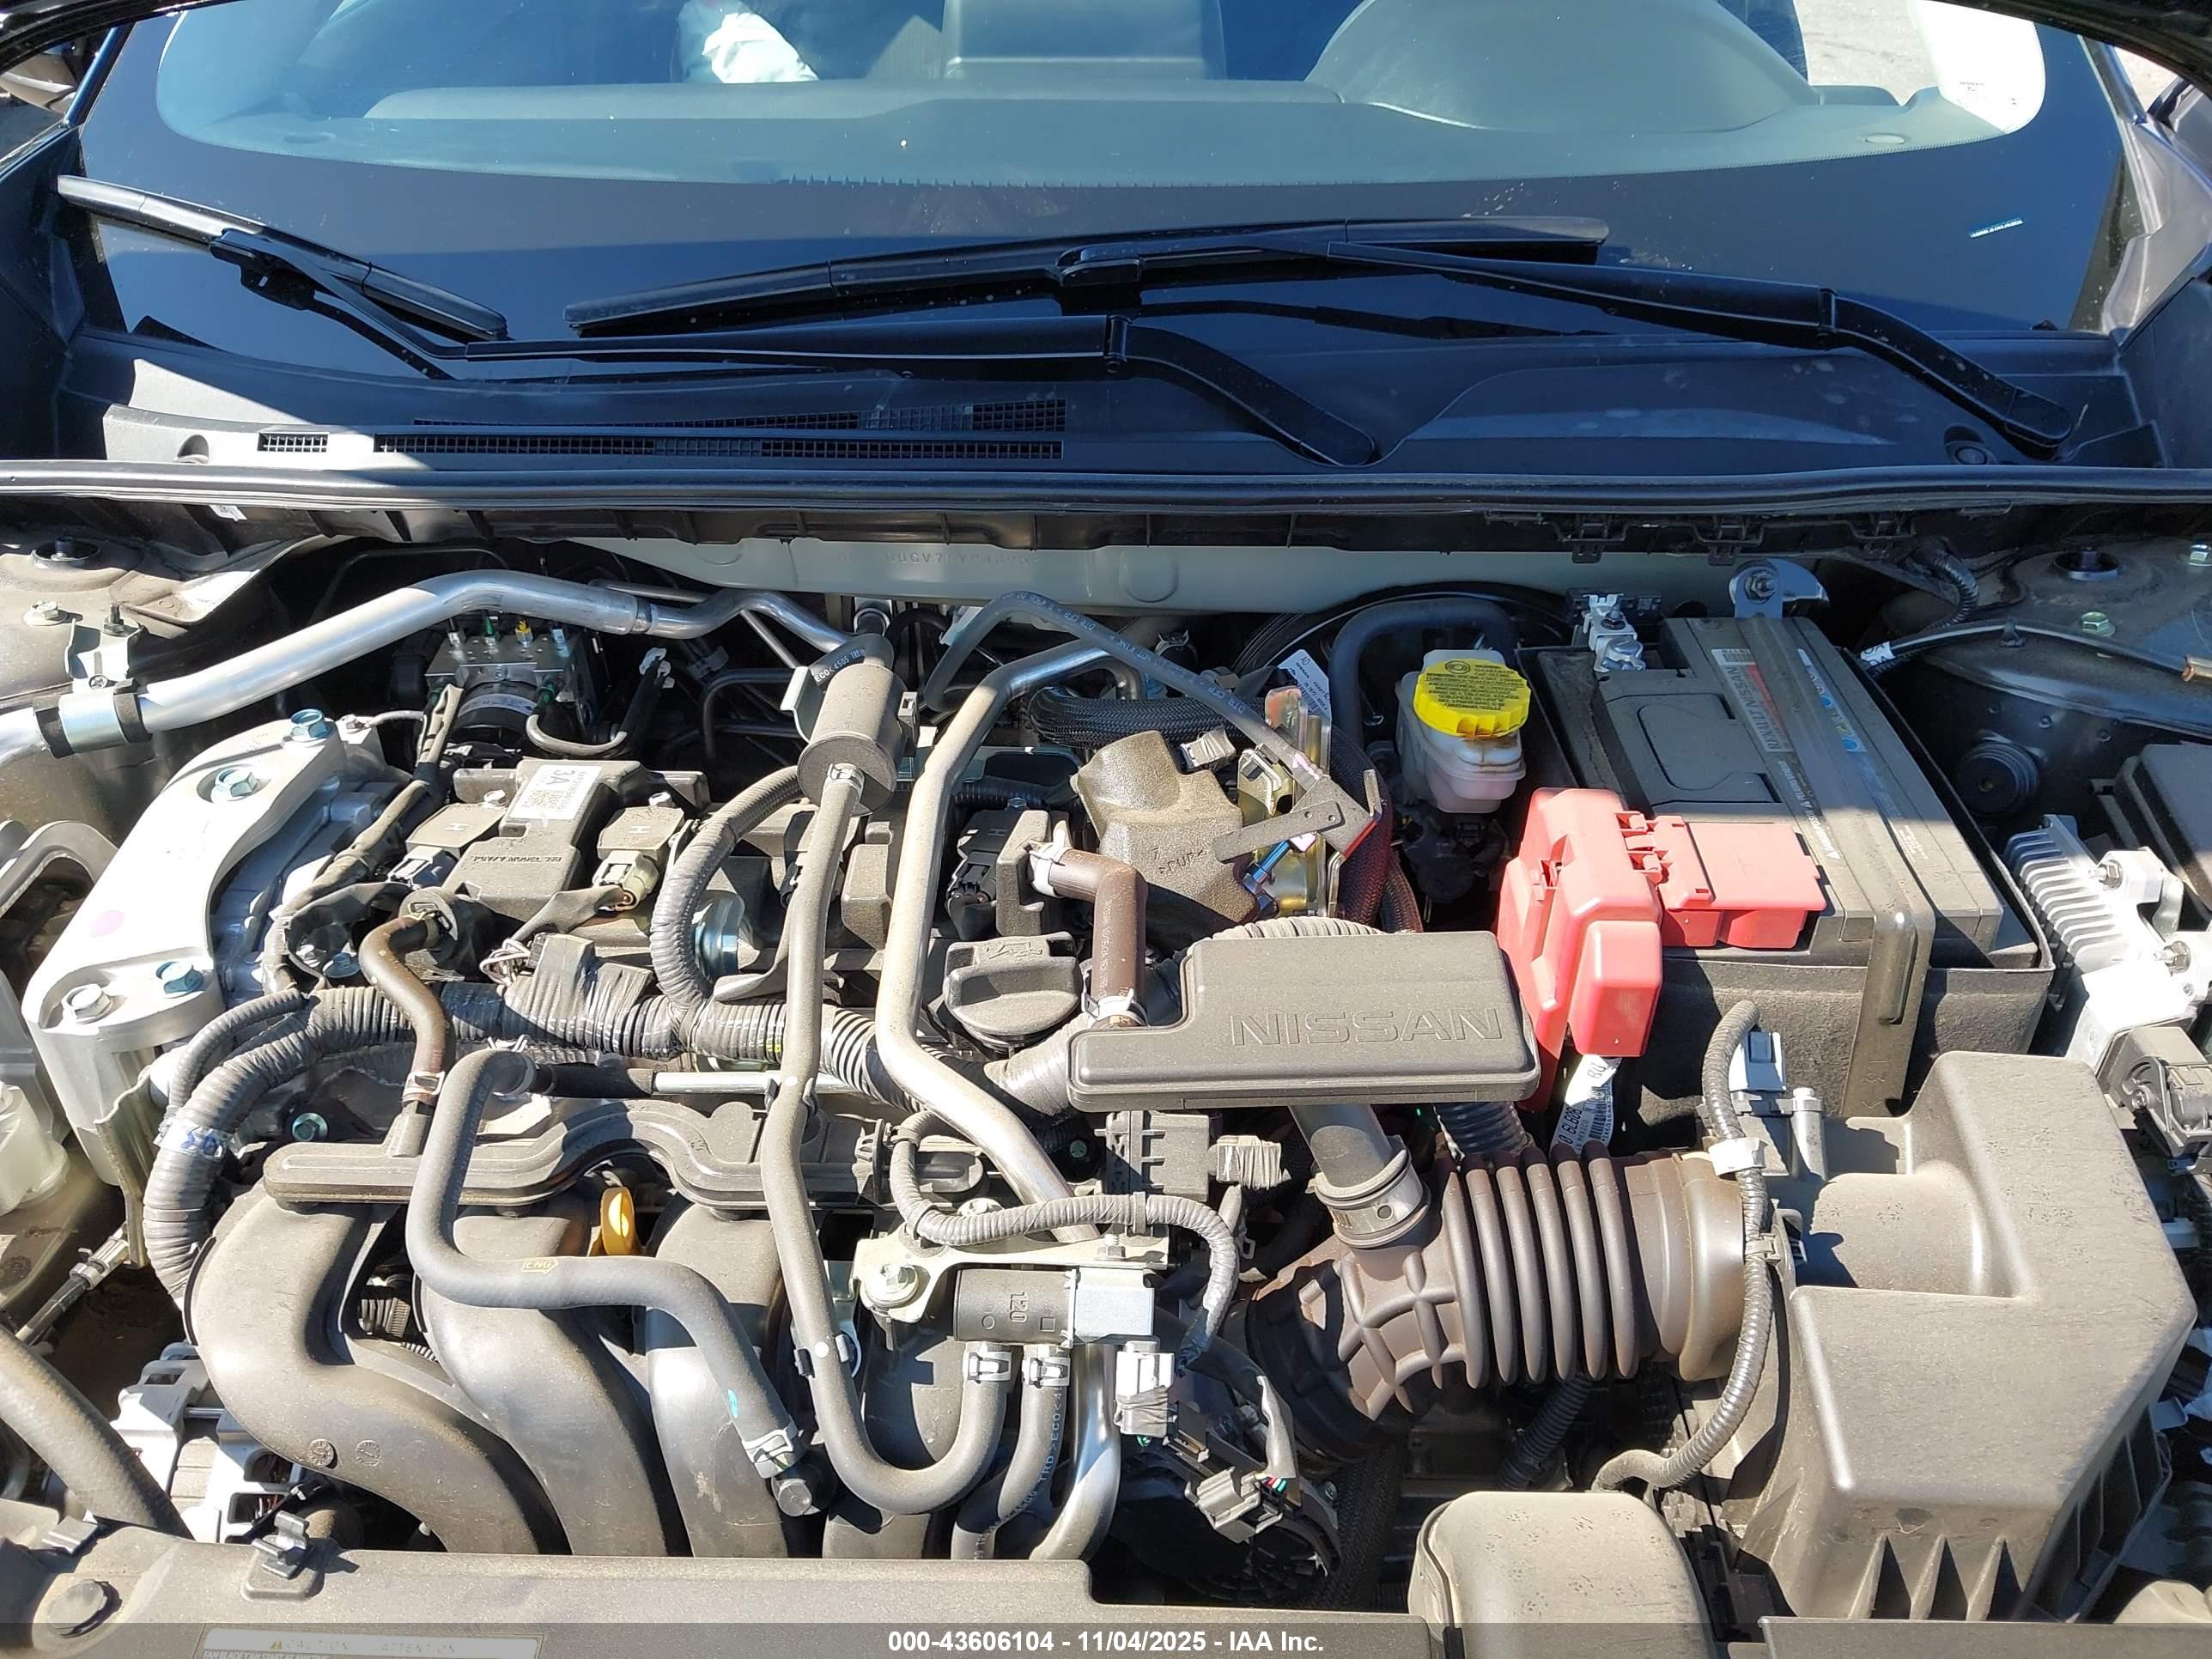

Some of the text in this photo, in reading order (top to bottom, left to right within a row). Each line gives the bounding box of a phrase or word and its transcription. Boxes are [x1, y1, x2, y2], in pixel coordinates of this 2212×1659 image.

[1725, 665, 1757, 708] NISSAN
[1230, 1008, 1503, 1046] NISSAN
[1009, 1291, 1029, 1323] 120
